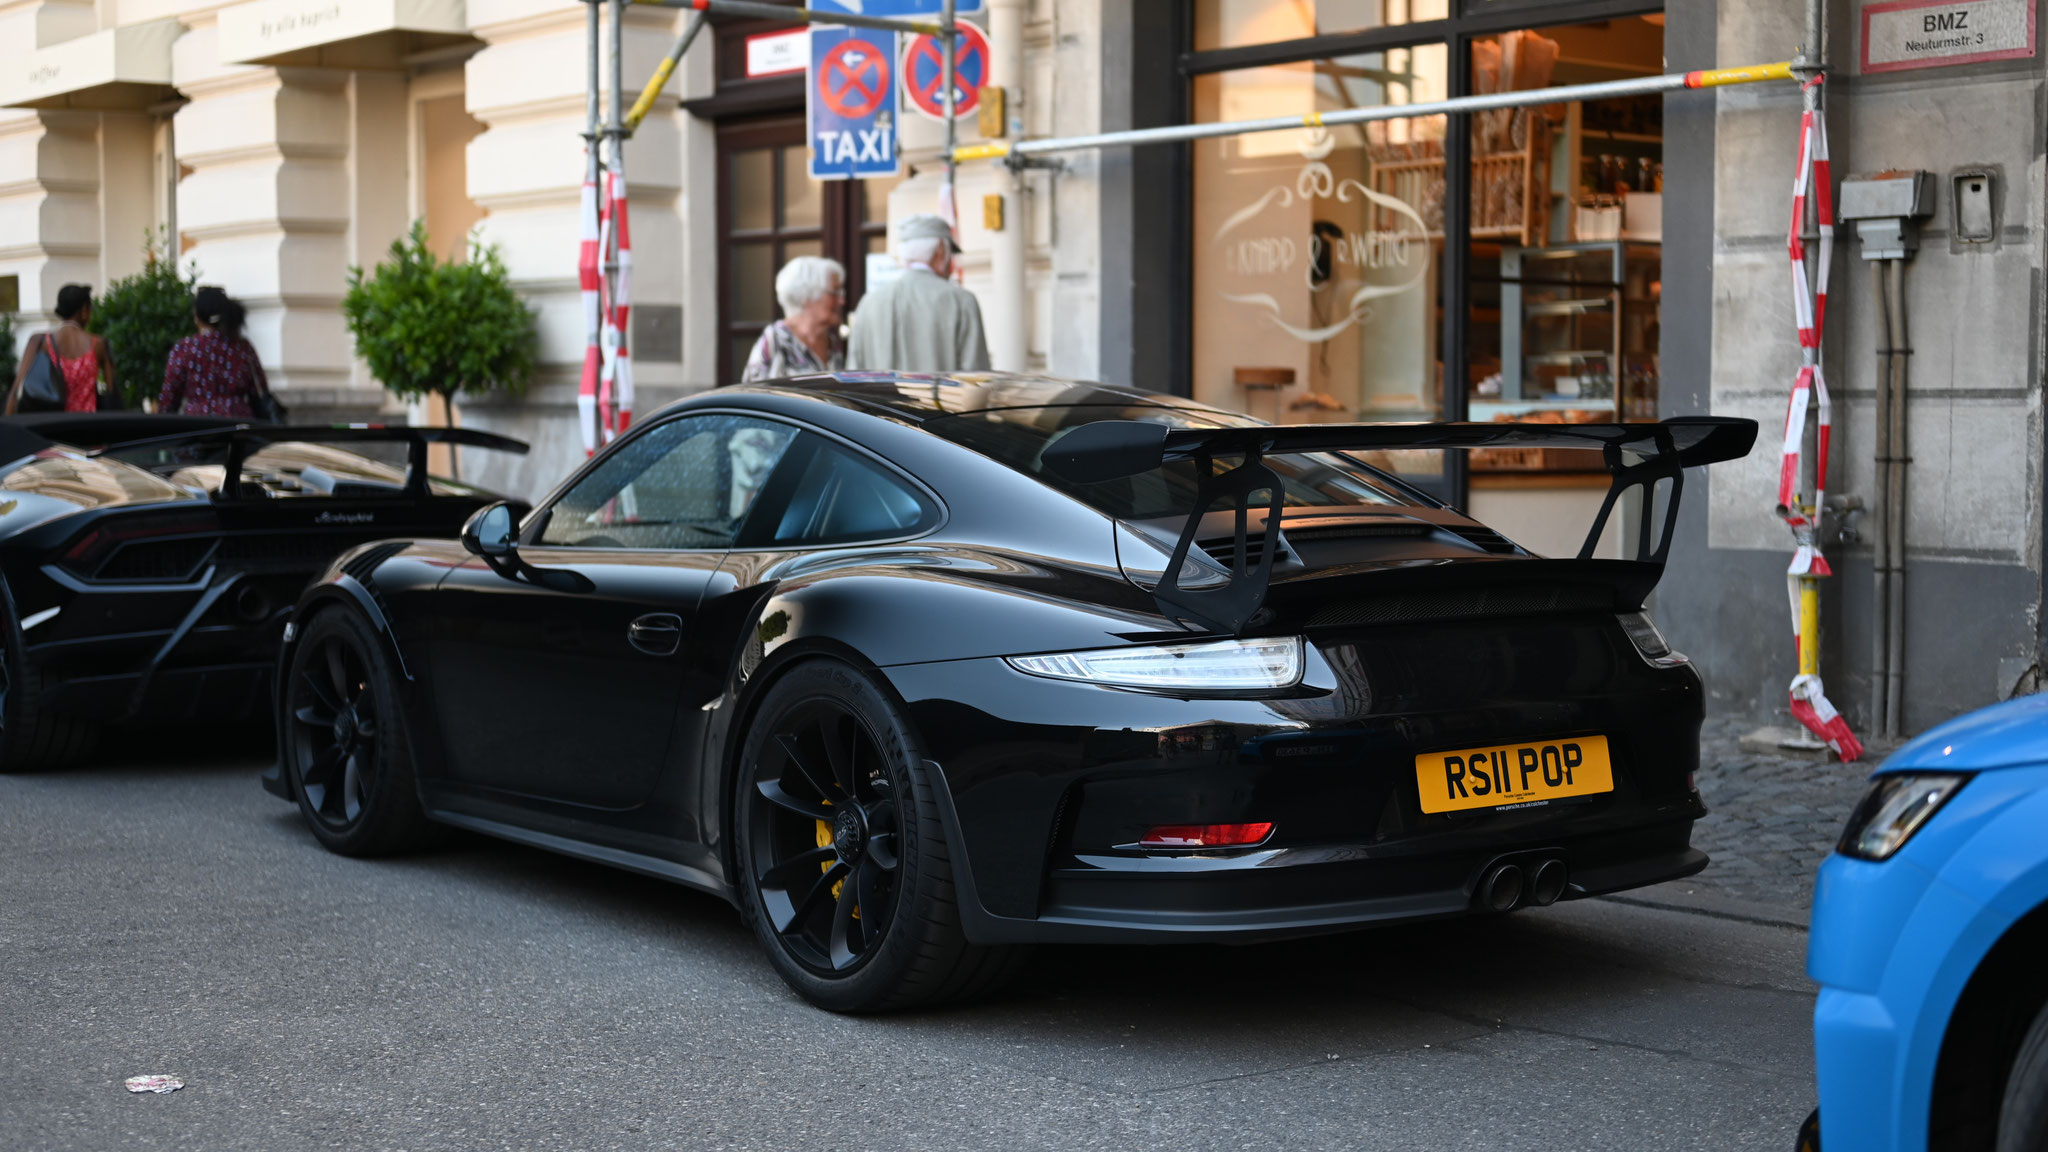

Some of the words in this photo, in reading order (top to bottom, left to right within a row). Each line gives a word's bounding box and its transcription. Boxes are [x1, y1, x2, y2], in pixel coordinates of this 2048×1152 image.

[1923, 11, 1969, 33] BMZ
[1906, 34, 1974, 52] Neuturmstr.
[1976, 33, 1984, 45] 3
[817, 128, 891, 164] TAXI
[1518, 743, 1582, 790] POP
